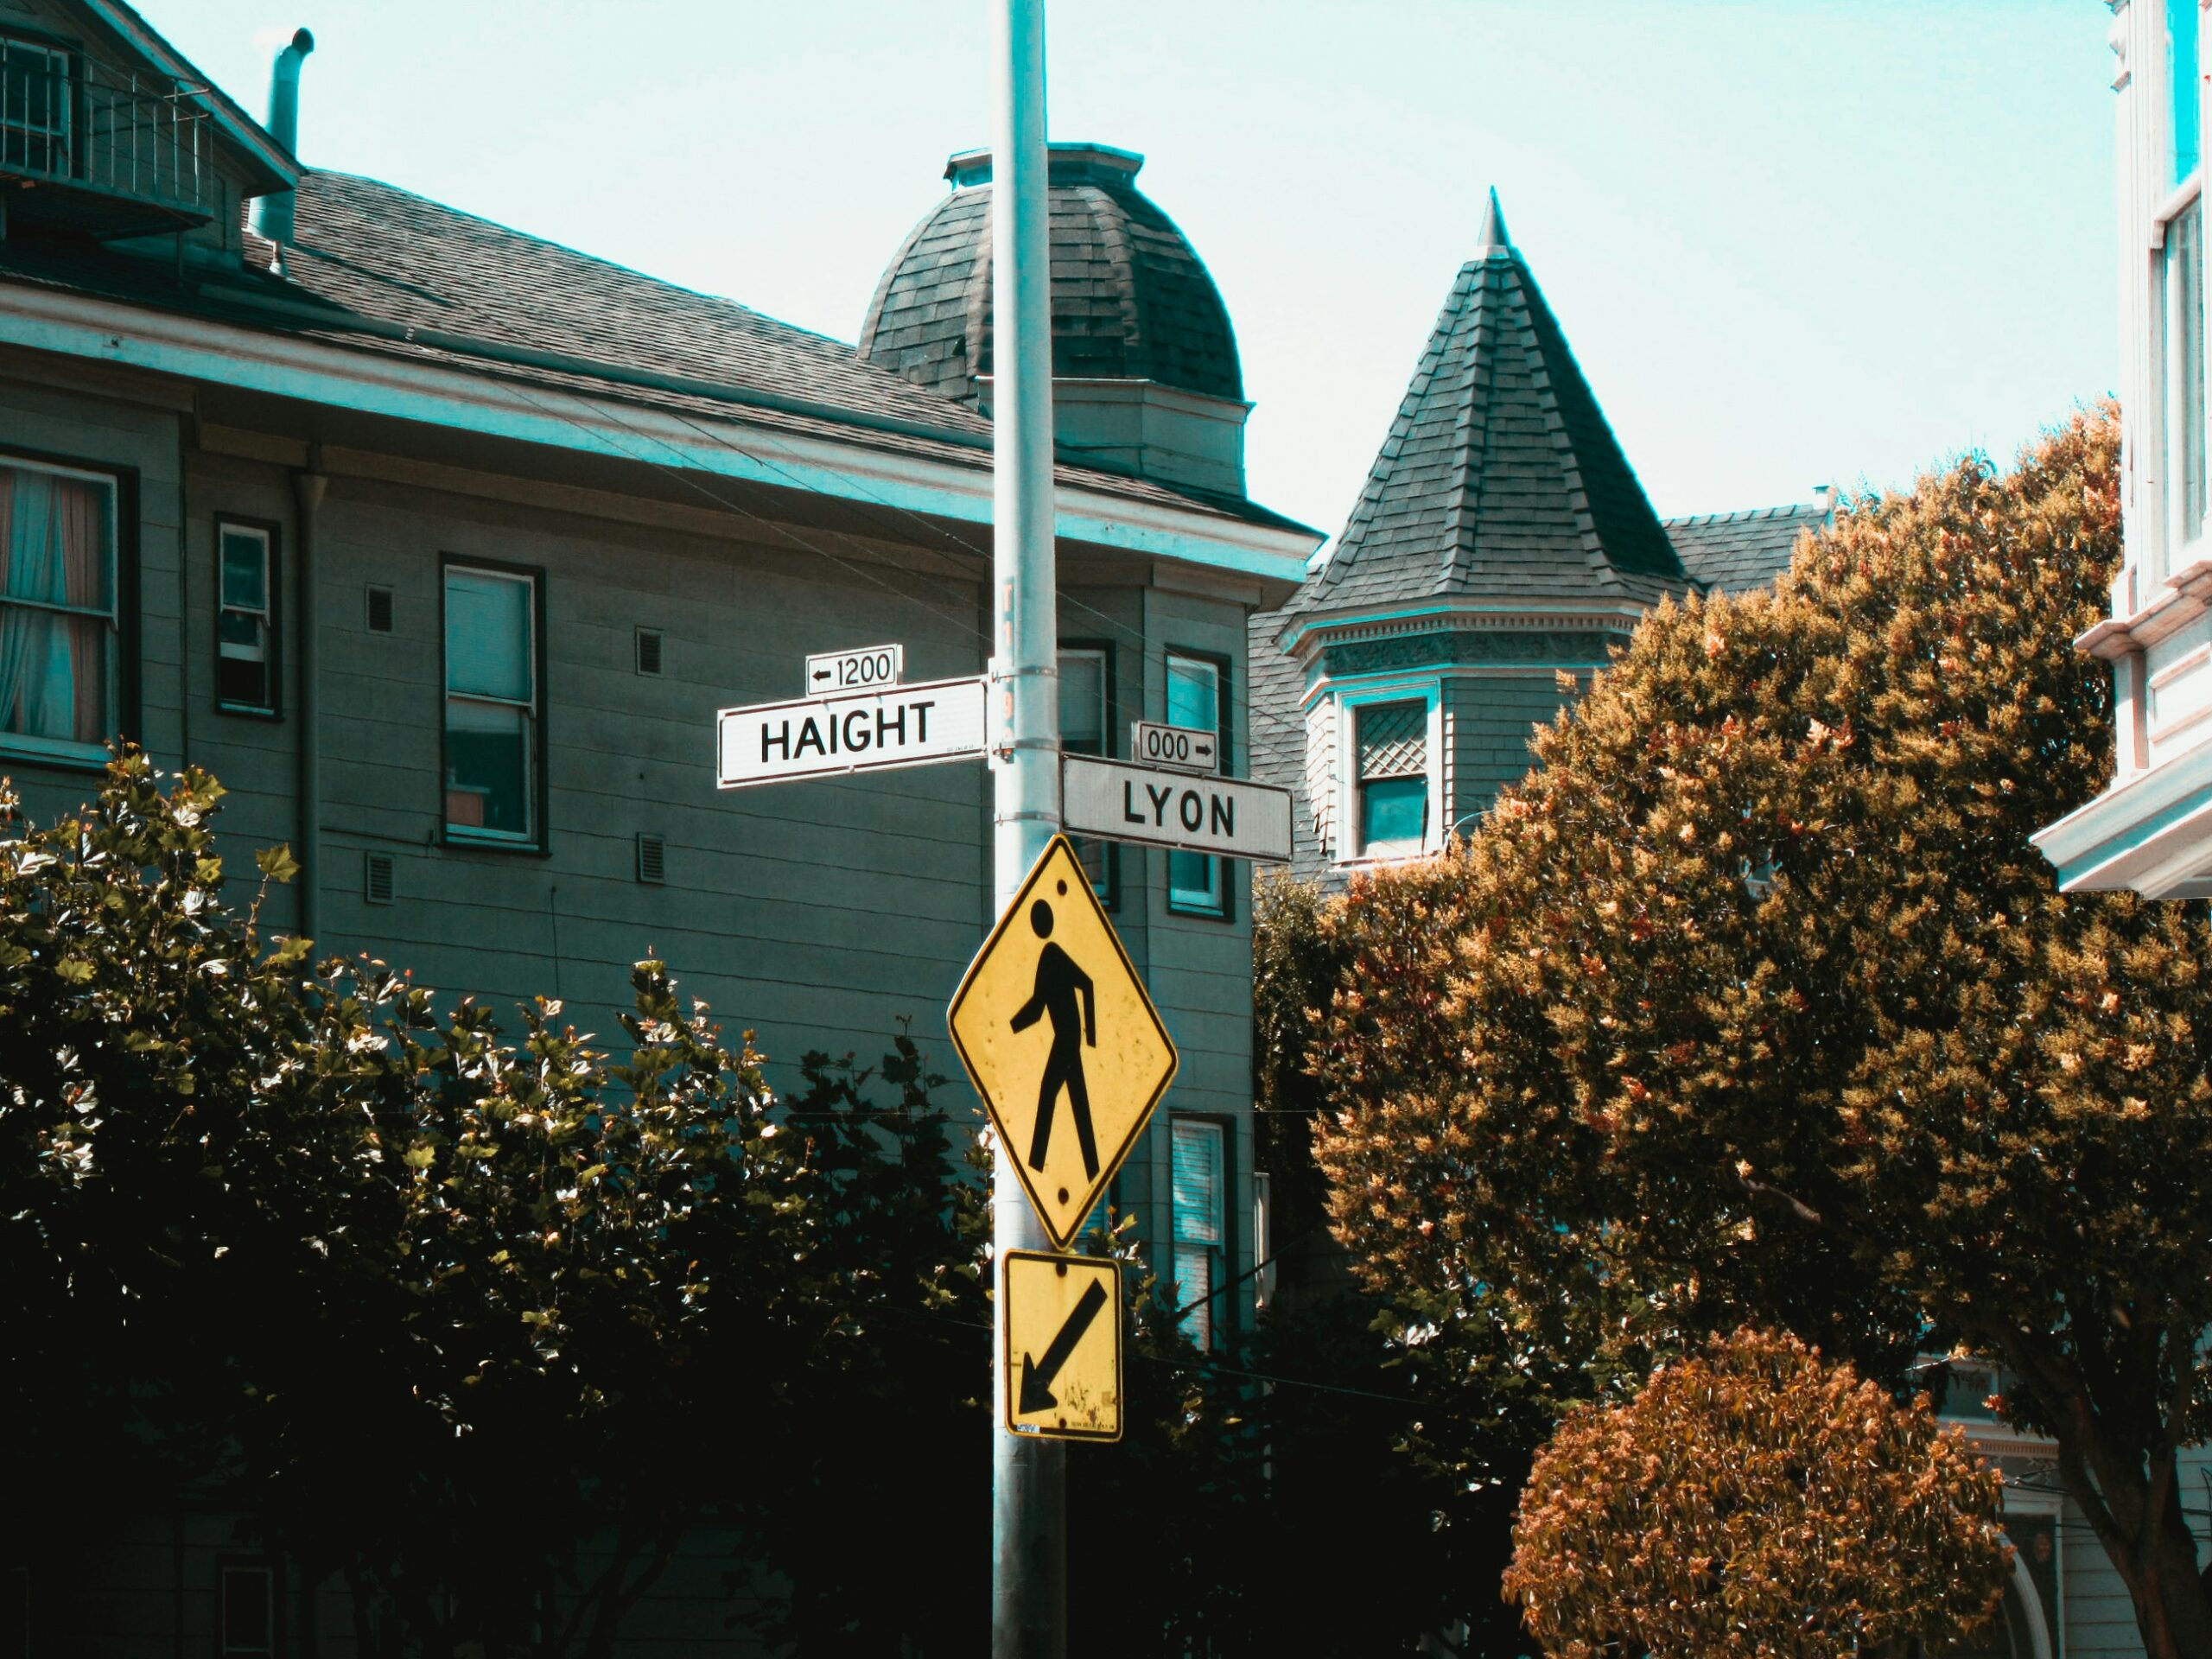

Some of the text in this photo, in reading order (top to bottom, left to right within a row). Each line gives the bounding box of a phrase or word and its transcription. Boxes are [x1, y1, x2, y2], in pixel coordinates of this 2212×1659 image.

[837, 653, 890, 686] 1200
[761, 701, 935, 763] HAIGHT
[1148, 730, 1188, 760] 000
[1124, 780, 1234, 837] LYON
